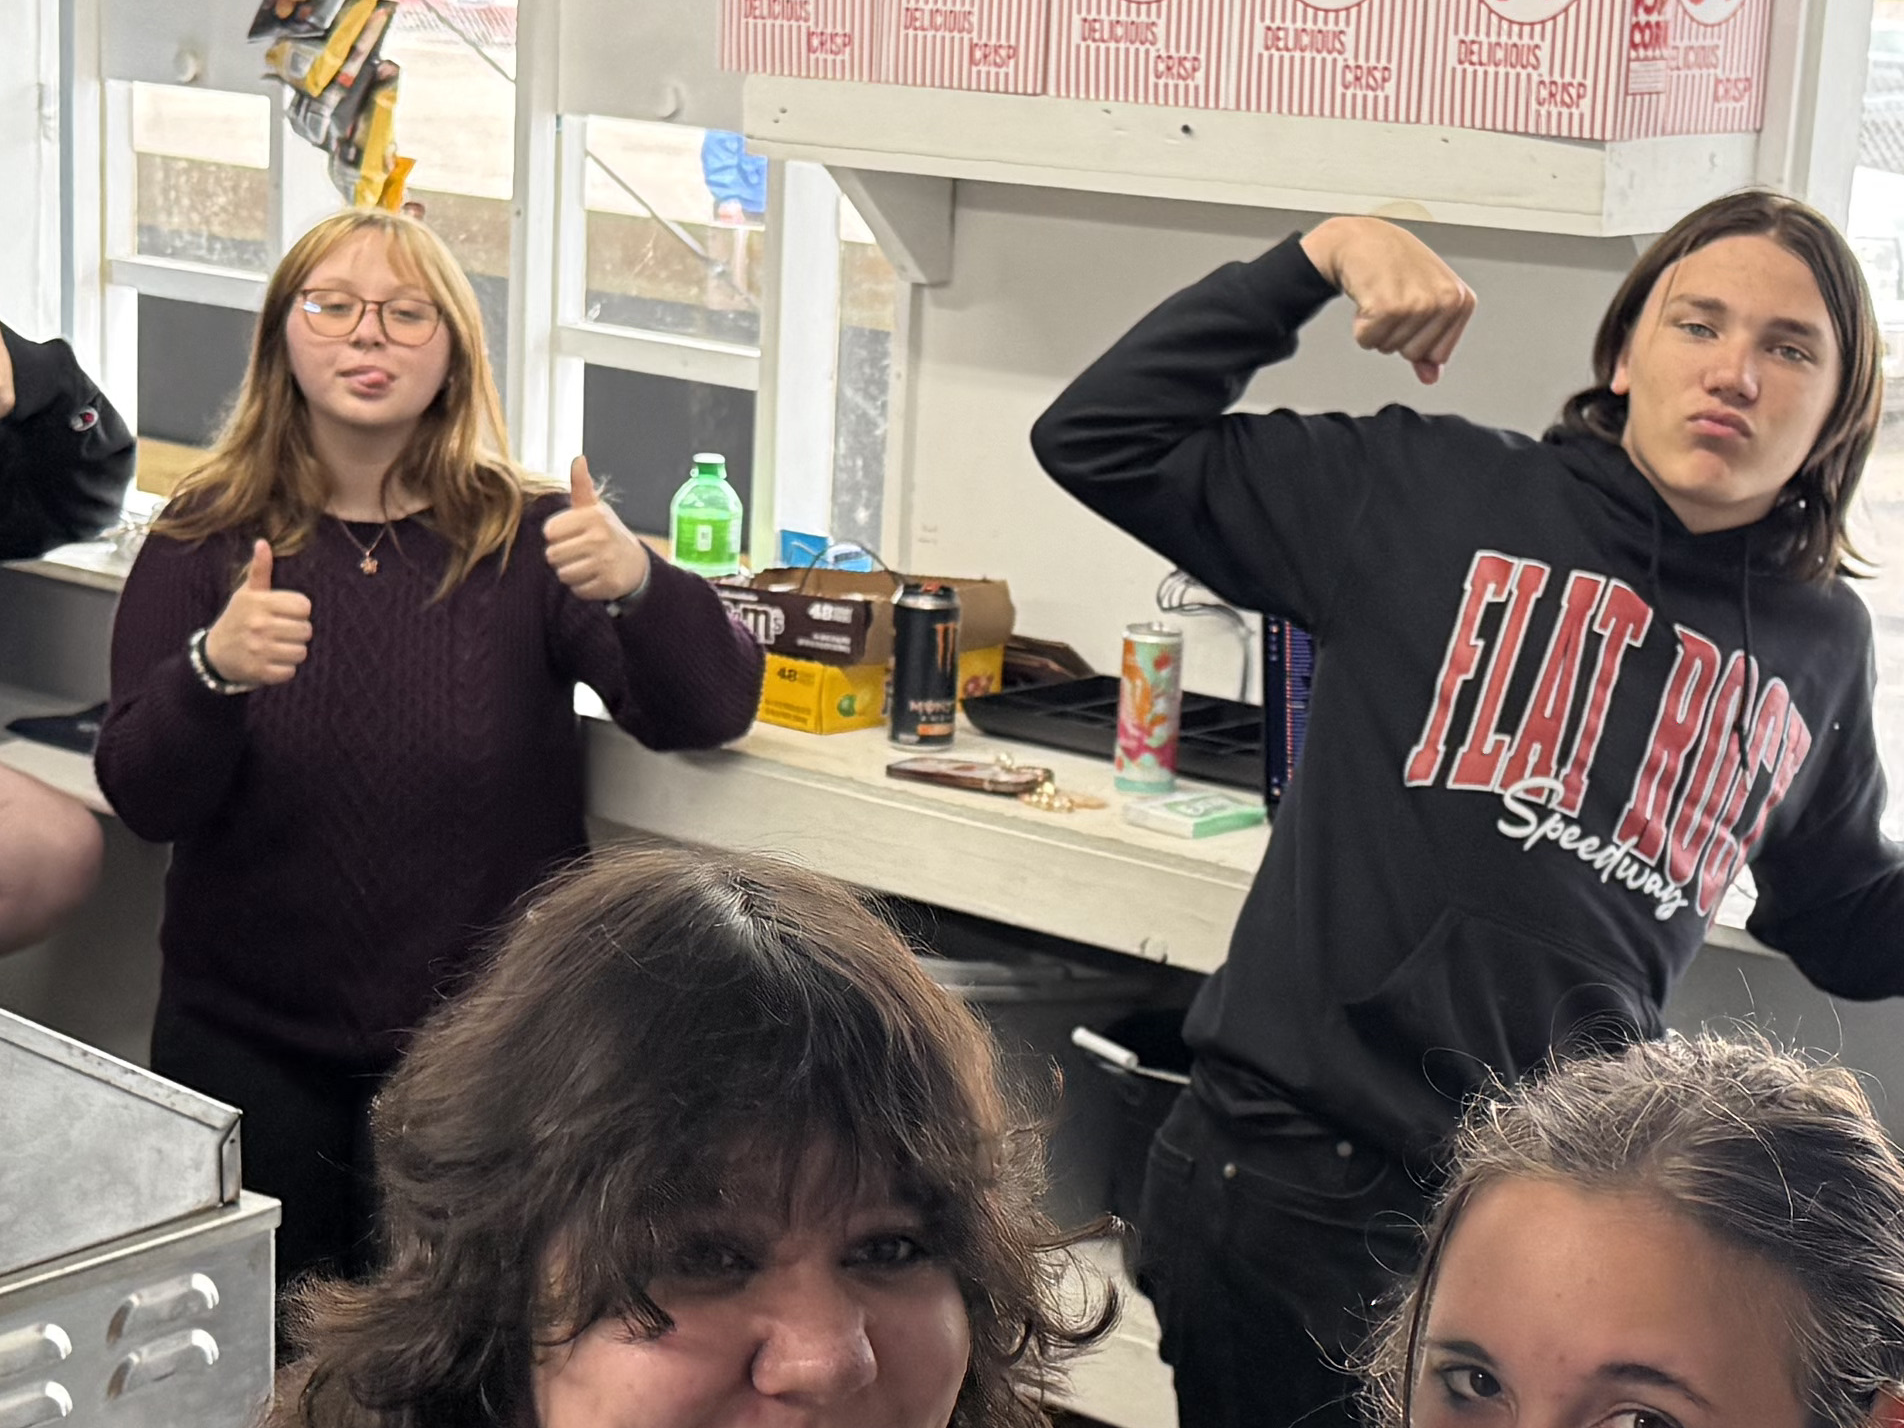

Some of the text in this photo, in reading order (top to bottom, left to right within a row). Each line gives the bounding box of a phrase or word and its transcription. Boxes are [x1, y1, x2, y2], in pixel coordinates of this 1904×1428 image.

[904, 7, 974, 34] DELICIOUS
[1081, 18, 1158, 46] DELICIOUS
[807, 30, 851, 56] CRISP
[1264, 26, 1346, 56] DELICIOUS
[1458, 39, 1542, 70] DELICIOUS
[971, 43, 1016, 69] CRISP
[1155, 55, 1200, 80] CRISP
[1342, 64, 1391, 92] CRISP
[1536, 79, 1587, 109] CRISP
[1404, 549, 1653, 818] FLAT
[1497, 777, 1689, 921] Speedway
